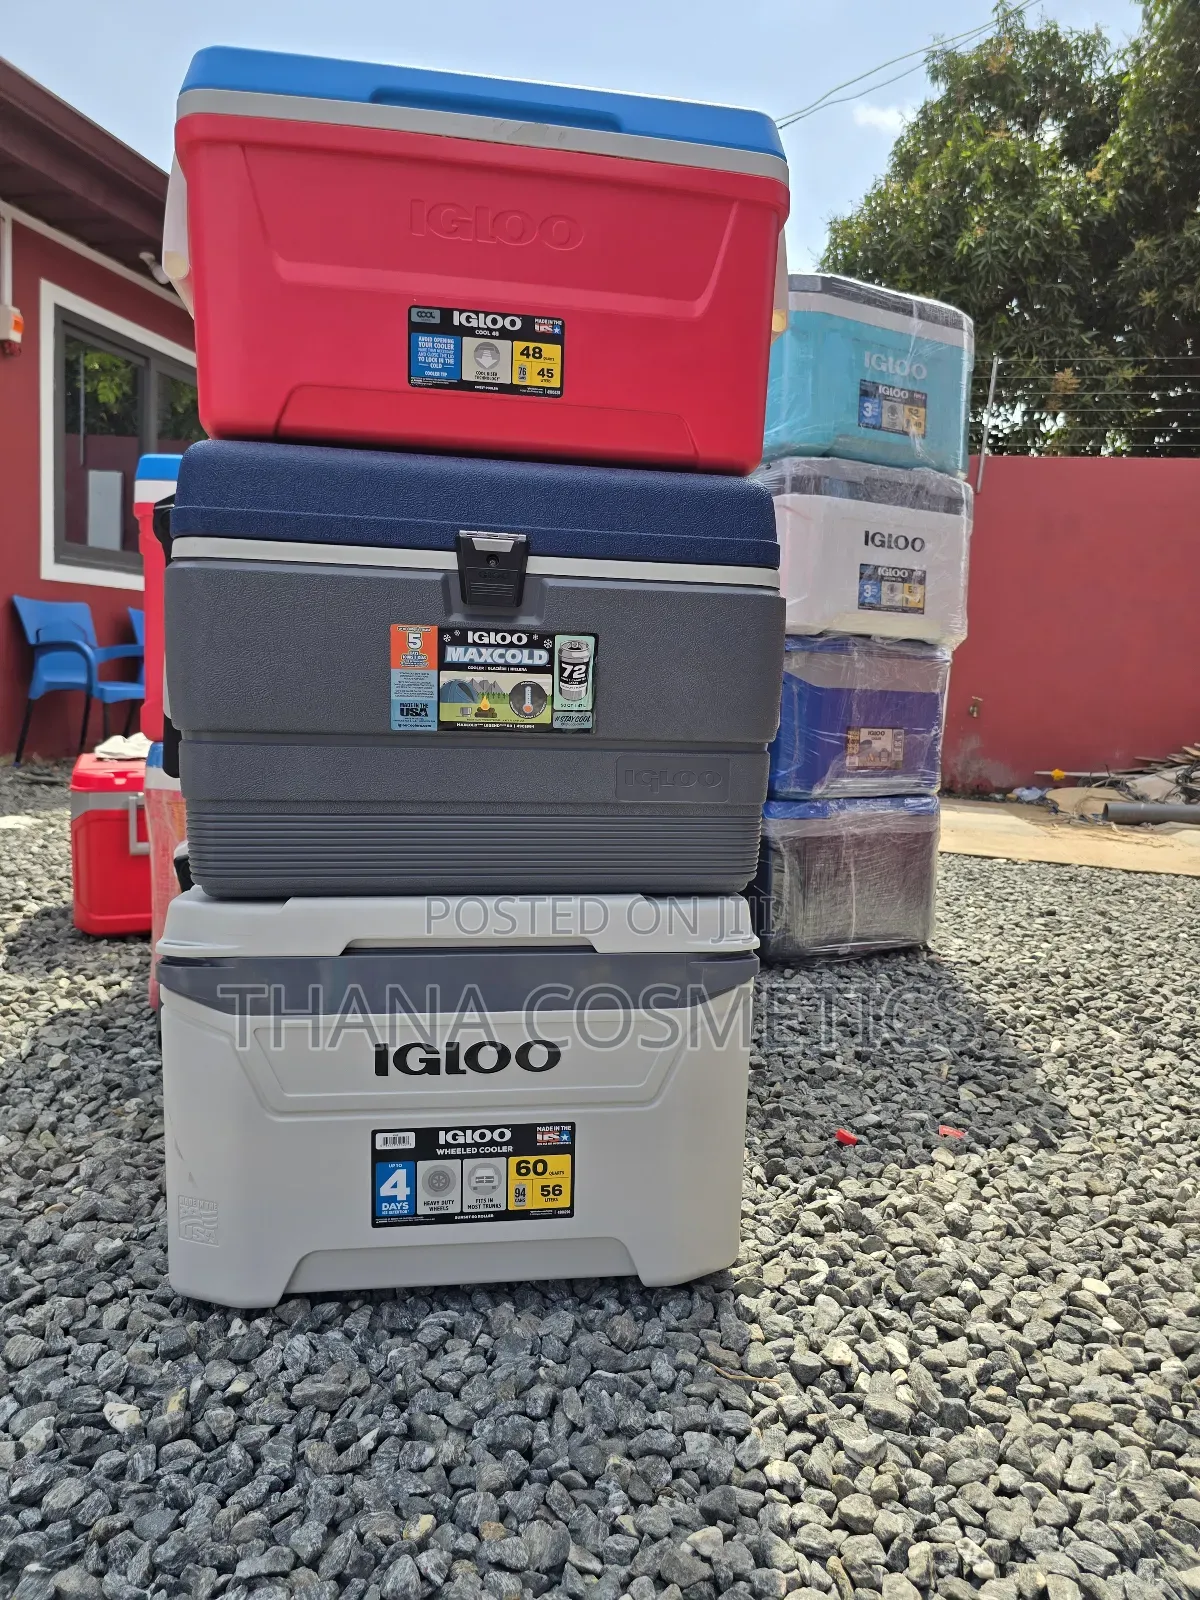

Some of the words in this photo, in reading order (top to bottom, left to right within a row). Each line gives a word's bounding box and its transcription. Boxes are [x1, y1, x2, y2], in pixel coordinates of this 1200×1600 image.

[410, 199, 584, 250] IGLOO
[416, 310, 436, 319] COOL
[453, 310, 522, 331] IGLOO
[434, 342, 454, 350] COOLER
[520, 345, 543, 360] 48
[518, 367, 527, 376] 76
[865, 351, 927, 380] IGLOO
[537, 368, 554, 379] 45
[878, 384, 909, 399] IGLOO
[862, 402, 873, 417] 3
[864, 530, 926, 552] IGLOO
[878, 567, 909, 577] IGLOO
[863, 584, 872, 597] 3
[408, 632, 422, 650] 5
[467, 630, 528, 645] IGLOO
[445, 645, 549, 665] MAXCOLD
[561, 662, 586, 679] 72
[400, 708, 428, 717] USA
[625, 769, 722, 794] IGLOO
[374, 1039, 562, 1077] IGLOO
[438, 1128, 512, 1145] IGLOO
[436, 1147, 478, 1156] WHEELED
[478, 1145, 514, 1154] COOLER
[515, 1158, 548, 1177] 60
[380, 1168, 410, 1201] 4
[540, 1184, 563, 1197] 56
[514, 1187, 526, 1198] 94
[382, 1202, 409, 1210] DAYS
